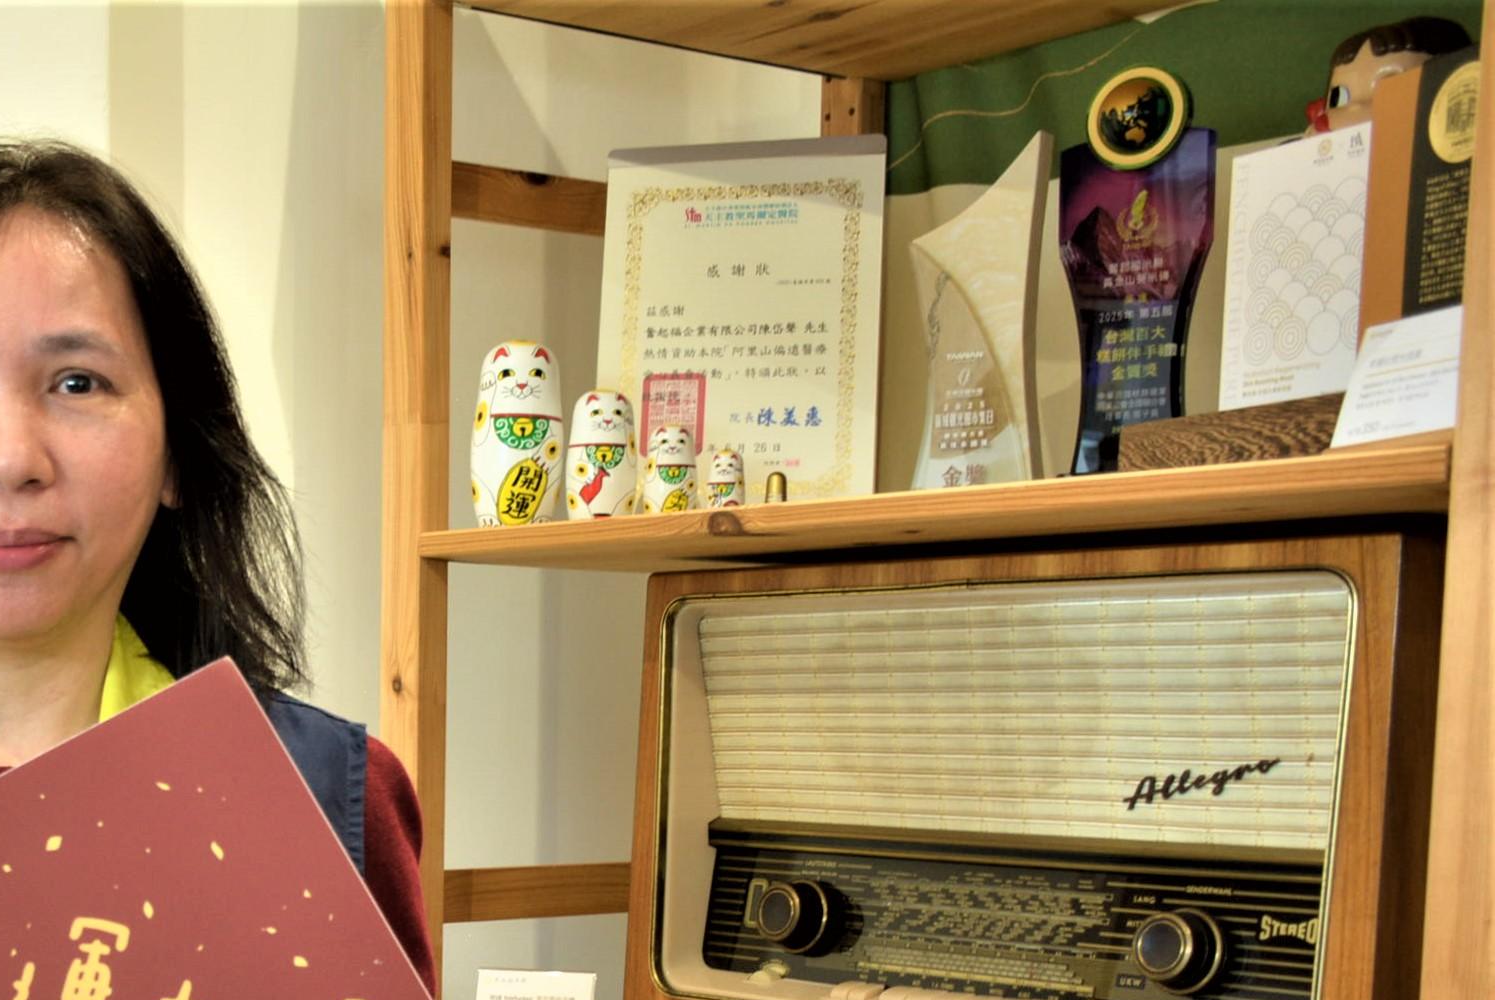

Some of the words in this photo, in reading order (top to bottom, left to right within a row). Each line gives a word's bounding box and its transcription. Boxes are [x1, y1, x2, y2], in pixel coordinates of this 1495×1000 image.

[501, 465, 544, 520] 開運
[1124, 758, 1282, 811] Allegro
[1259, 914, 1318, 944] STEREO
[1118, 977, 1144, 988] UKW
